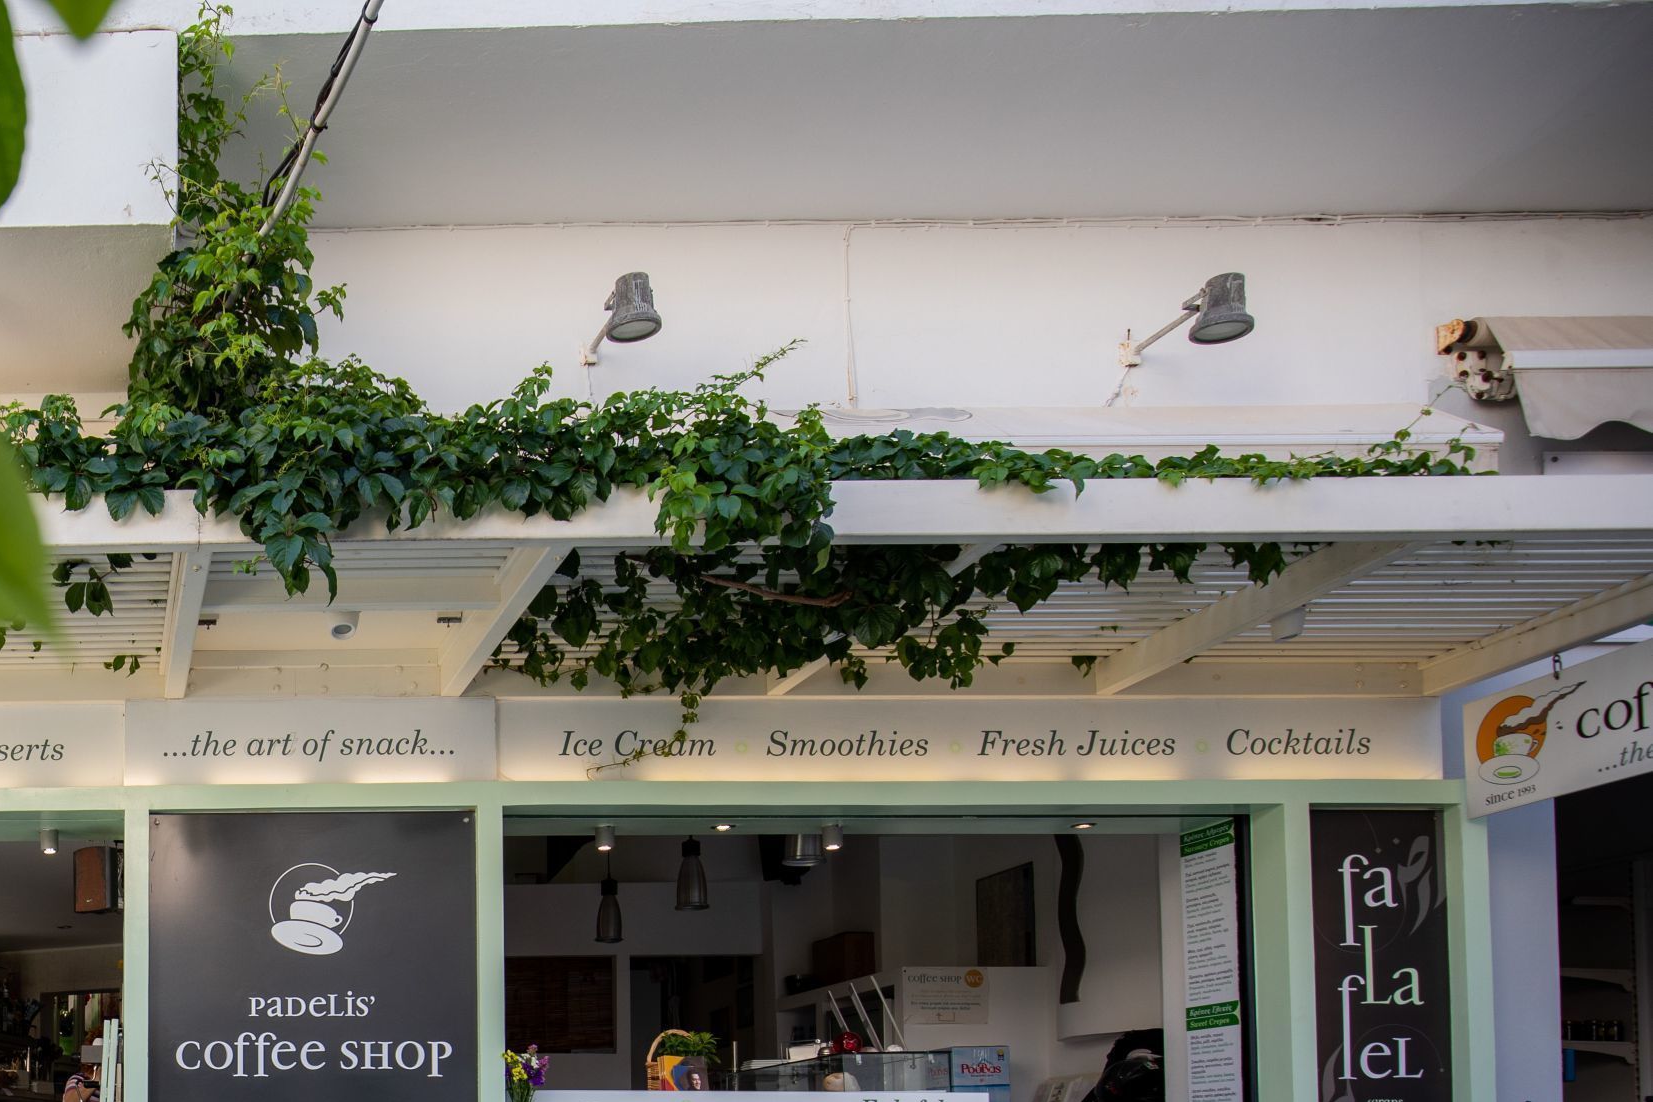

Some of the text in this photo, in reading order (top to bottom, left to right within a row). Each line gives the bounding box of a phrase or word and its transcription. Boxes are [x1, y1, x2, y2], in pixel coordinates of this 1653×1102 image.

[247, 733, 292, 756] art
[302, 730, 335, 762] of
[340, 729, 454, 756] snack...
[558, 730, 716, 756] Ice Cream
[766, 730, 929, 756] Smoothies
[977, 729, 1176, 756] Fresh Juices
[1226, 728, 1371, 756] Cocktails
[1485, 784, 1536, 805] since 1993
[966, 975, 982, 983] WC
[175, 1032, 452, 1077] coffee SHOP
